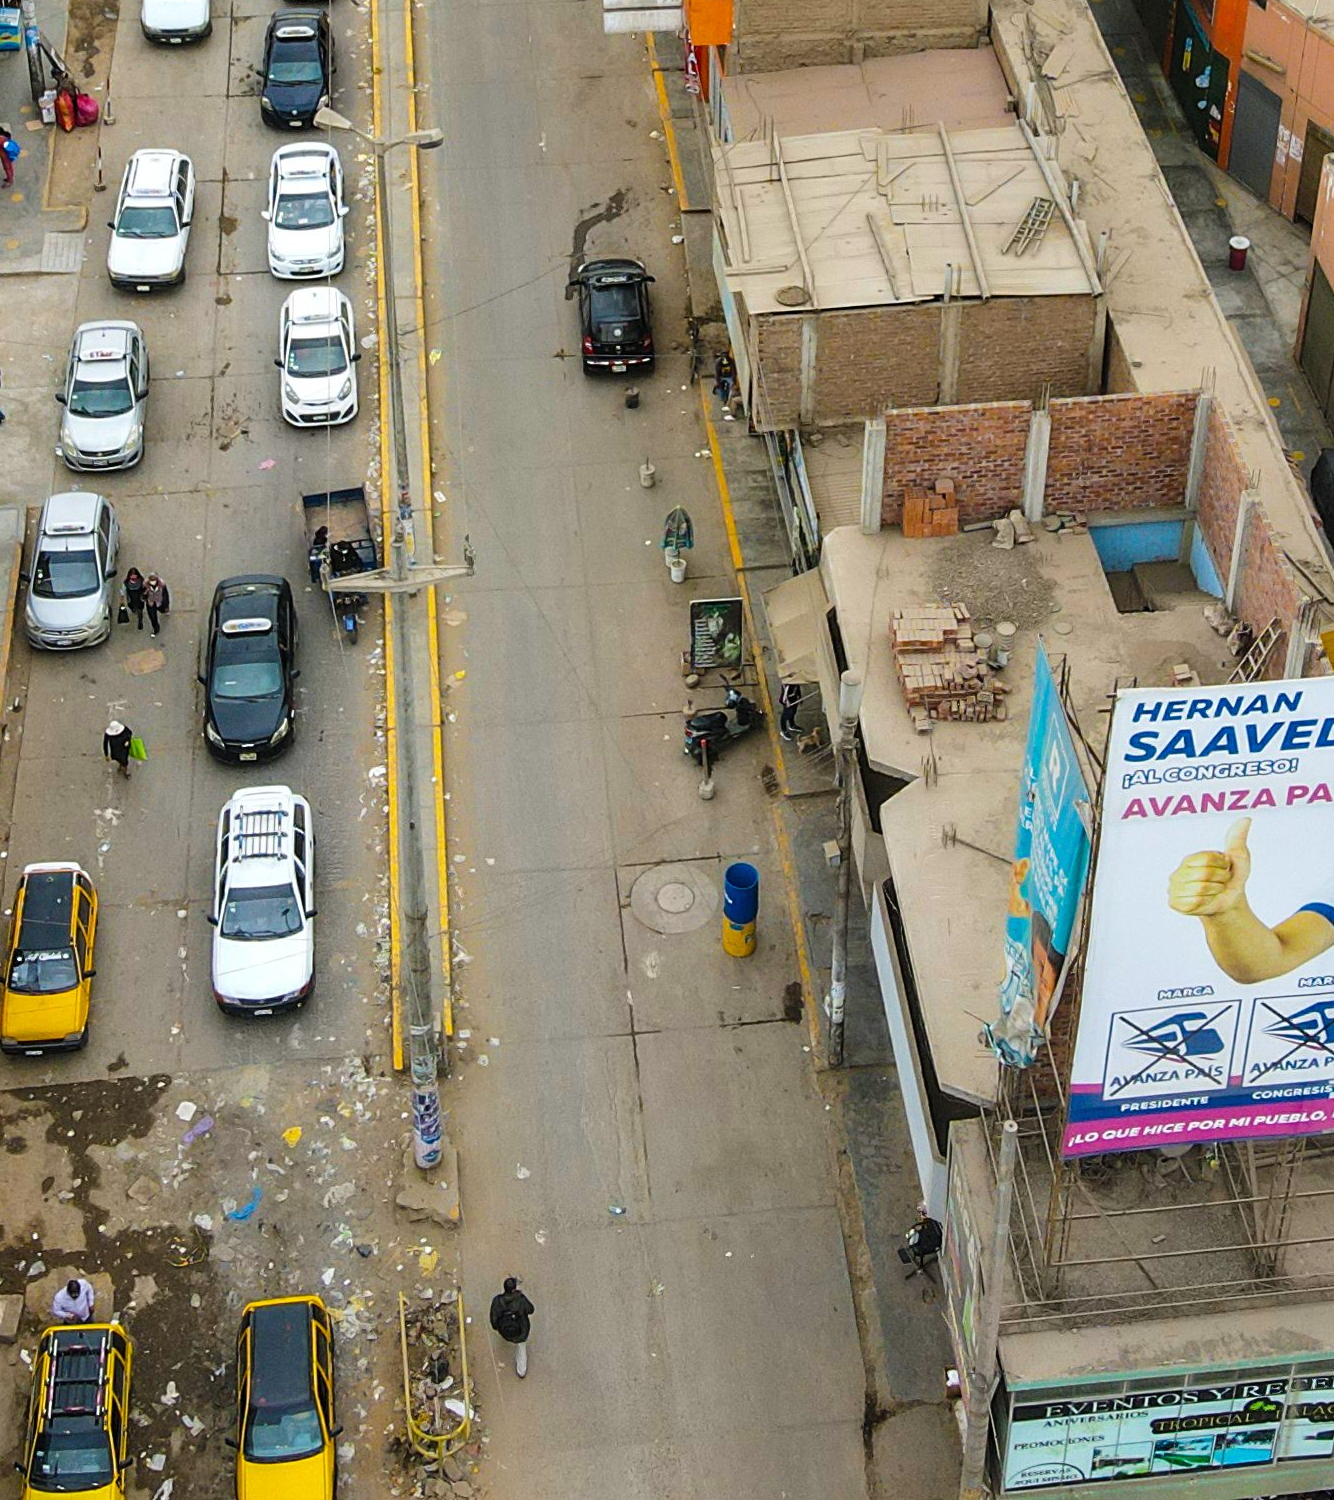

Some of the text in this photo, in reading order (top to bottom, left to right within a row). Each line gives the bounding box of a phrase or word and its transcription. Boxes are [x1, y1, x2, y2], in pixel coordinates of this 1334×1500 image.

[1132, 691, 1303, 723] HERNAN
[1122, 758, 1299, 789] ¡AL CONGRESO!
[1121, 788, 1276, 819] AVANZA
[1158, 985, 1214, 1000] MARCA
[1250, 1056, 1319, 1074] AVANZA
[1110, 1065, 1223, 1087] AVANZA PAÍS
[1120, 1096, 1209, 1112] PRESIDENTE
[1068, 1131, 1098, 1148] ¡LO
[1102, 1127, 1140, 1140] QUE
[1142, 1122, 1183, 1136] HICE
[1187, 1118, 1225, 1132] POR
[1228, 1115, 1251, 1128] MI
[1252, 1110, 1327, 1127] PUEBLO,
[1045, 1390, 1198, 1418] EVENTOS
[1210, 1385, 1237, 1401] Y
[1043, 1411, 1149, 1428] ANIVERSARIOS
[1155, 1412, 1255, 1432] TROPICAL
[1013, 1435, 1105, 1450] PROMOCIONES
